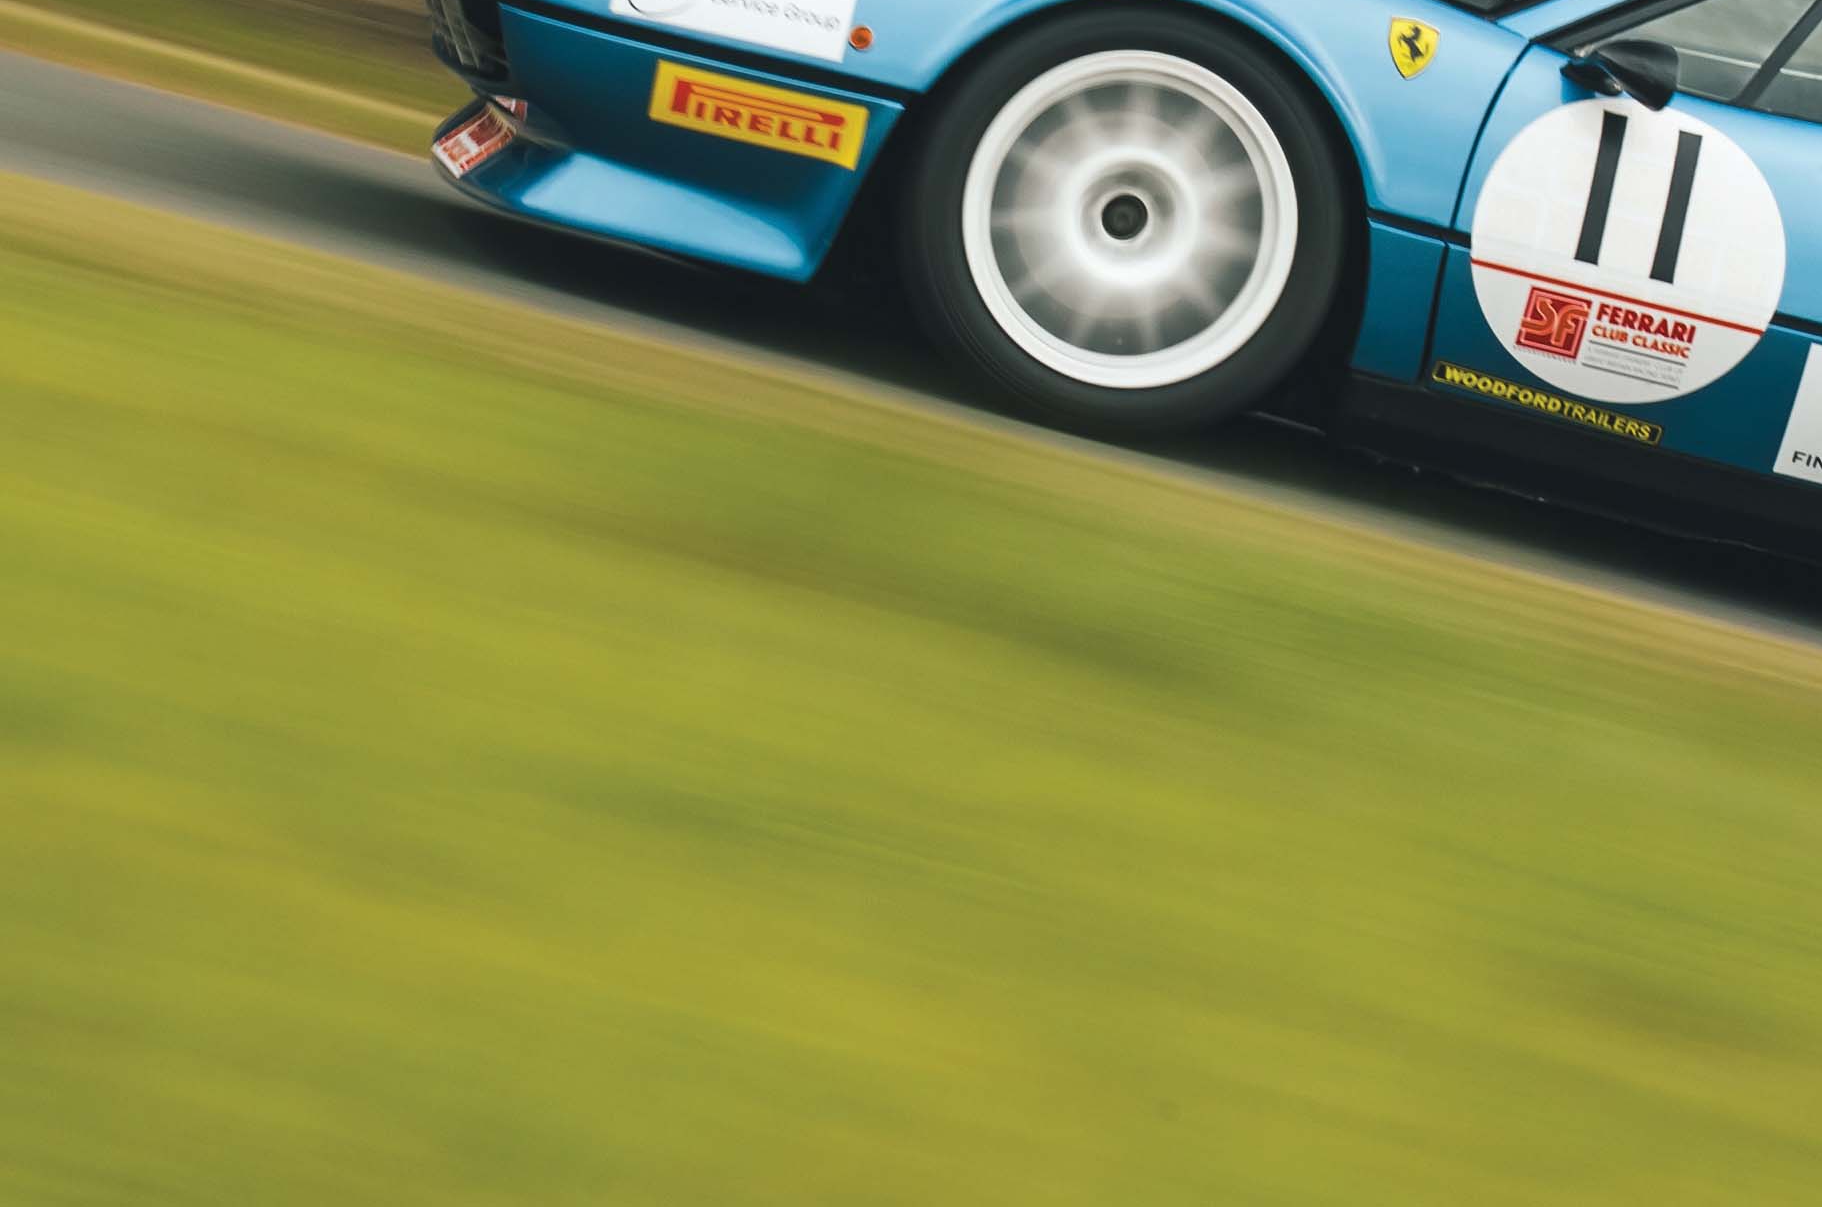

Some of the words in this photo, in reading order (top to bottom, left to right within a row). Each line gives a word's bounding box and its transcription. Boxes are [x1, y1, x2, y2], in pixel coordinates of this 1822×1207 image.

[670, 79, 846, 151] PIRELLI
[1574, 110, 1702, 284] 11
[1592, 325, 1628, 344] CLUB
[1632, 334, 1690, 359] CLASSIC
[1596, 303, 1696, 344] FERRARI
